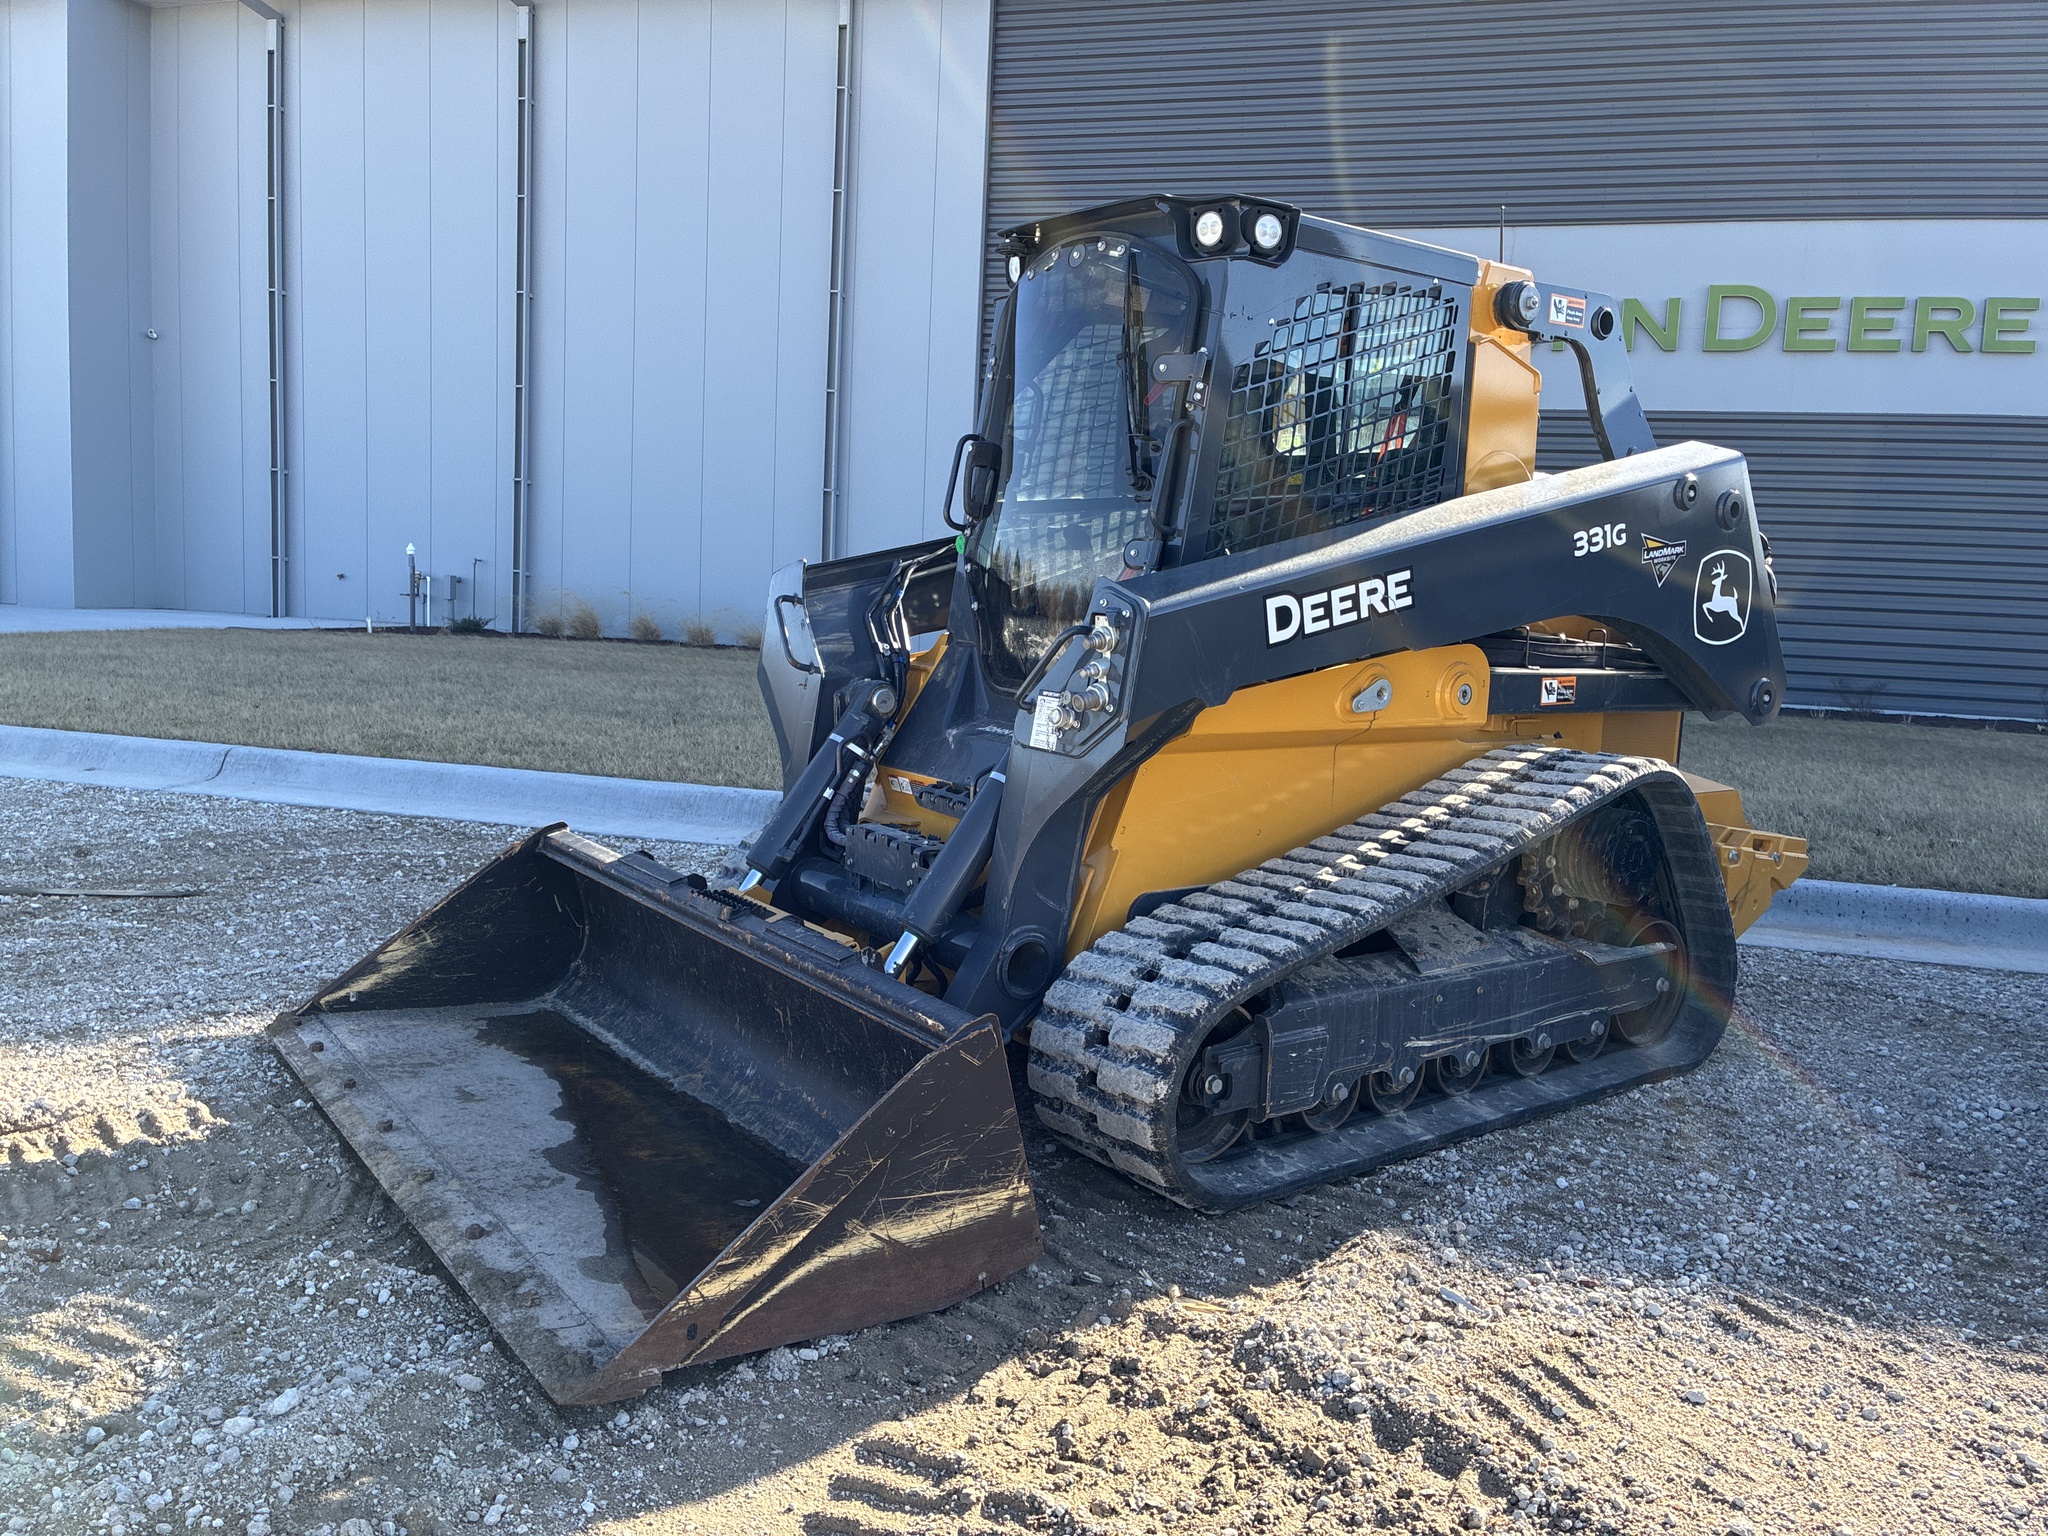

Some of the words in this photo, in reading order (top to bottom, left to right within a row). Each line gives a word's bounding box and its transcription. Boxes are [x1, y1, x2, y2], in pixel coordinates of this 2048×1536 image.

[1703, 284, 2040, 353] DEERE
[1573, 523, 1627, 557] 331G
[1644, 545, 1685, 559] LANDMARK
[1265, 569, 1413, 645] DEERE
